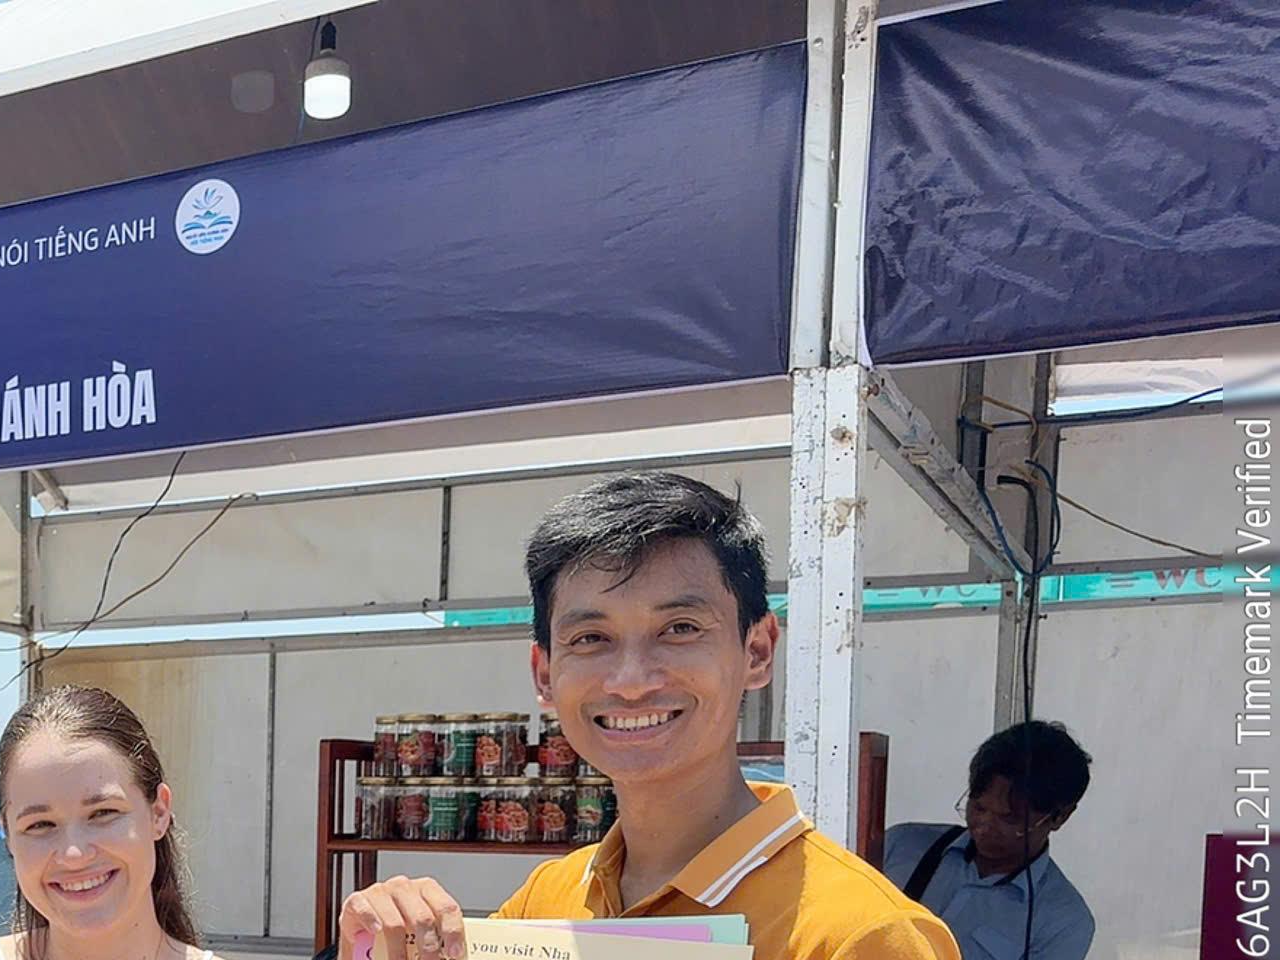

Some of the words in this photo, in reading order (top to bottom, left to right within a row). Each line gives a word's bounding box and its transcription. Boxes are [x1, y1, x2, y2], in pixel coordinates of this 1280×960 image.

[34, 226, 99, 261] TIẾNG
[104, 216, 156, 249] ANH
[82, 360, 157, 432] HÒA
[499, 943, 534, 956] visit
[538, 947, 571, 960] Nha
